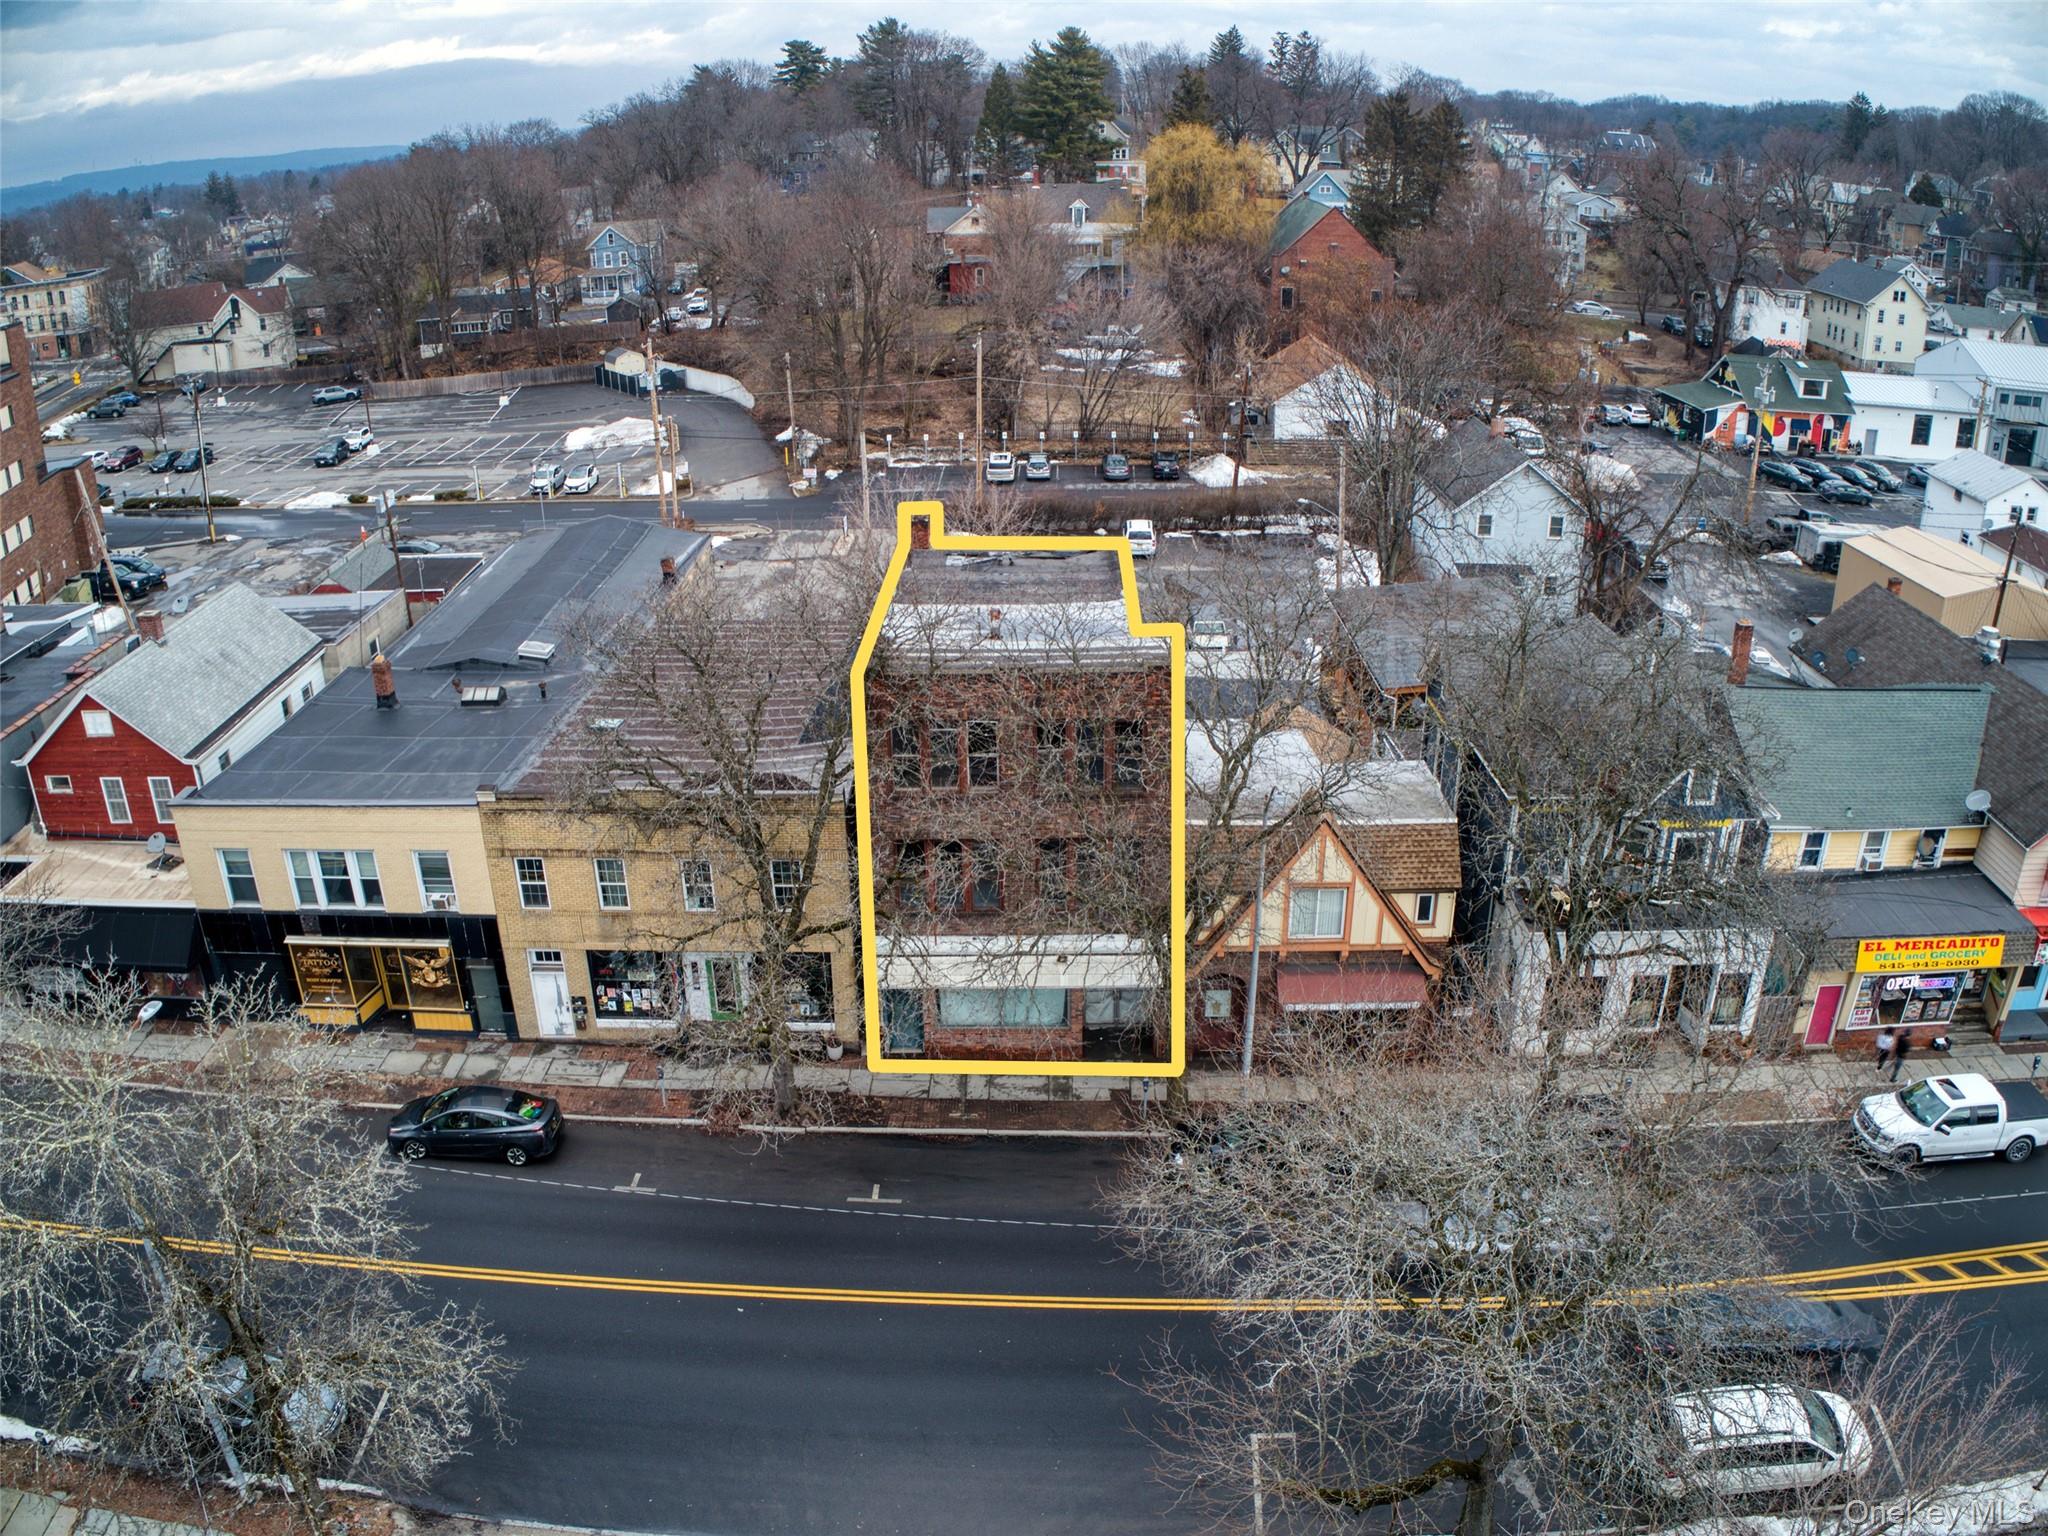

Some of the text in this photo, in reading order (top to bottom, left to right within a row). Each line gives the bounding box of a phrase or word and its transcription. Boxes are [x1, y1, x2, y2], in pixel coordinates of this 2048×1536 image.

[1864, 938, 2000, 952] EL MERCADITO
[1905, 952, 1927, 960] and
[1930, 949, 1987, 959] GROCERY
[301, 959, 338, 967] TATTOO
[1879, 959, 1980, 970] 845-943-5930
[1886, 975, 1920, 991] OPEN
